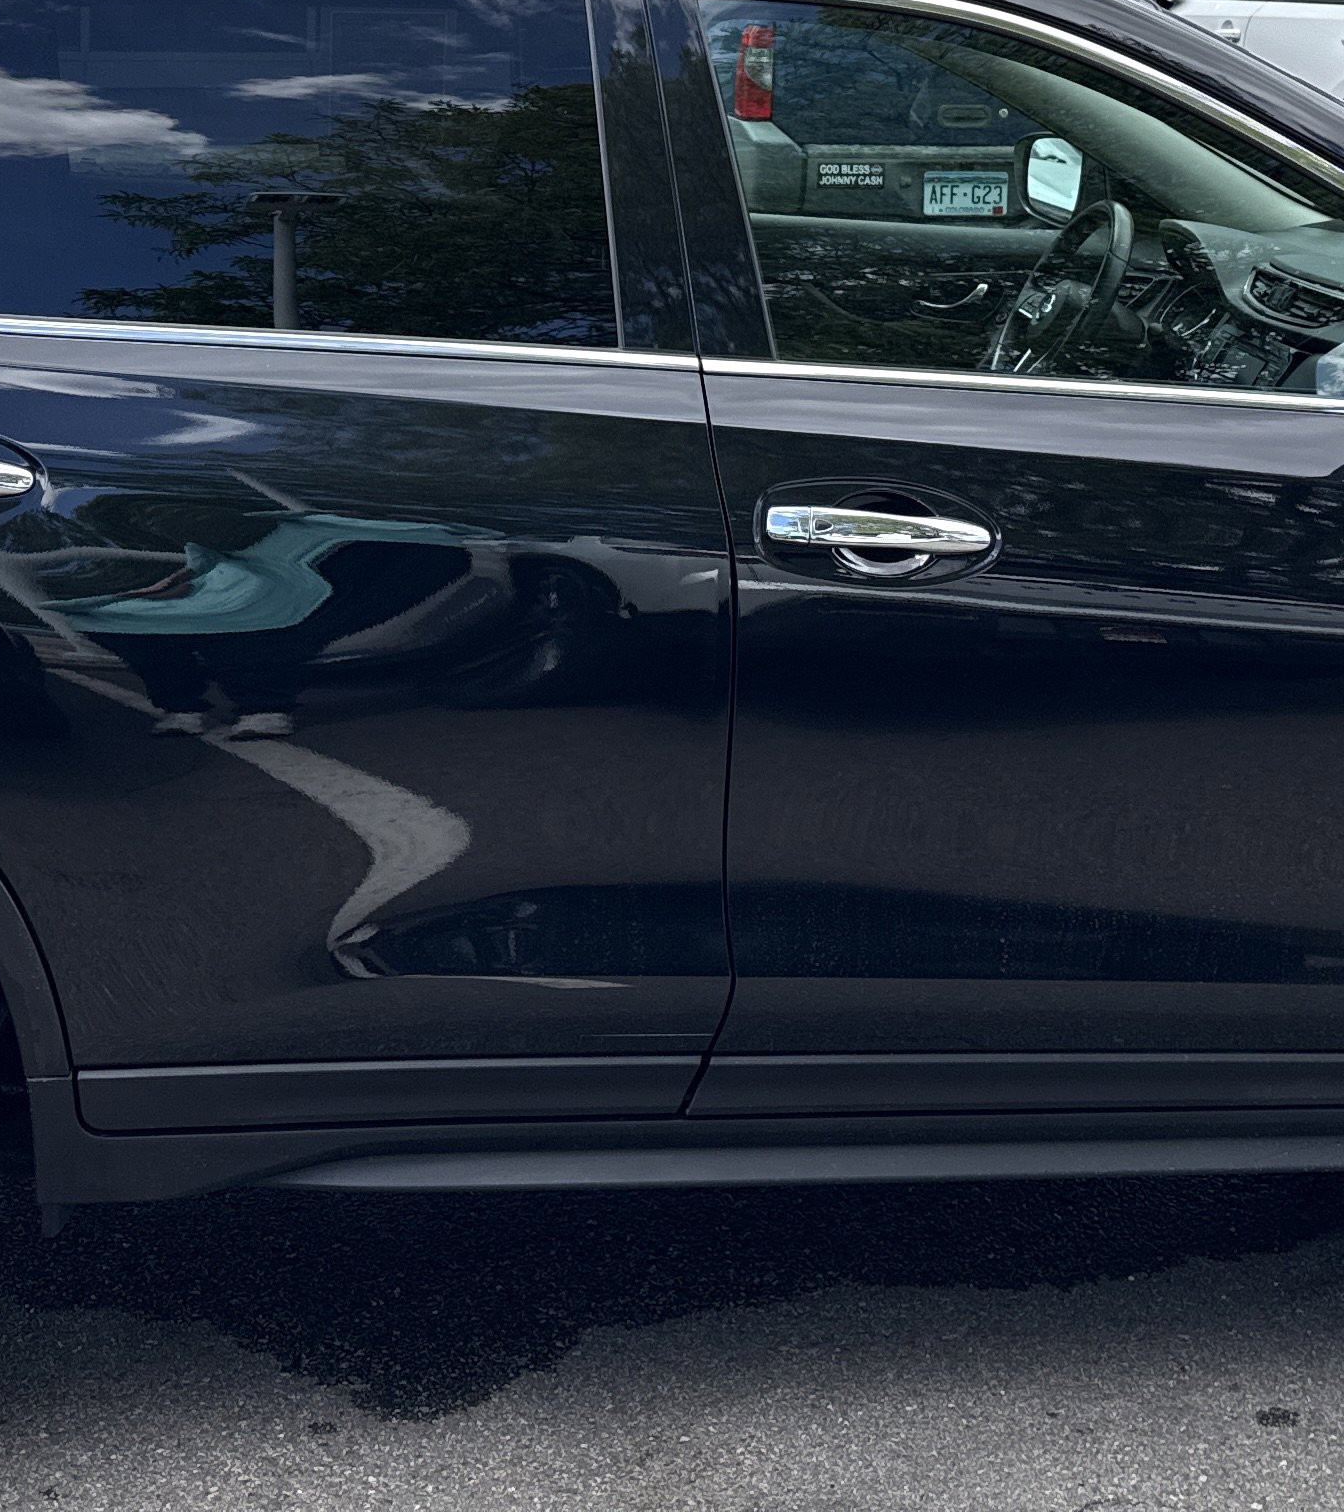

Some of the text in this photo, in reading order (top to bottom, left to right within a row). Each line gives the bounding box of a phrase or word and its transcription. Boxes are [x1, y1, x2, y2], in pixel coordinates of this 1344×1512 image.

[819, 164, 870, 175] GOD BLESS
[819, 176, 883, 185] JOHNNY CASH
